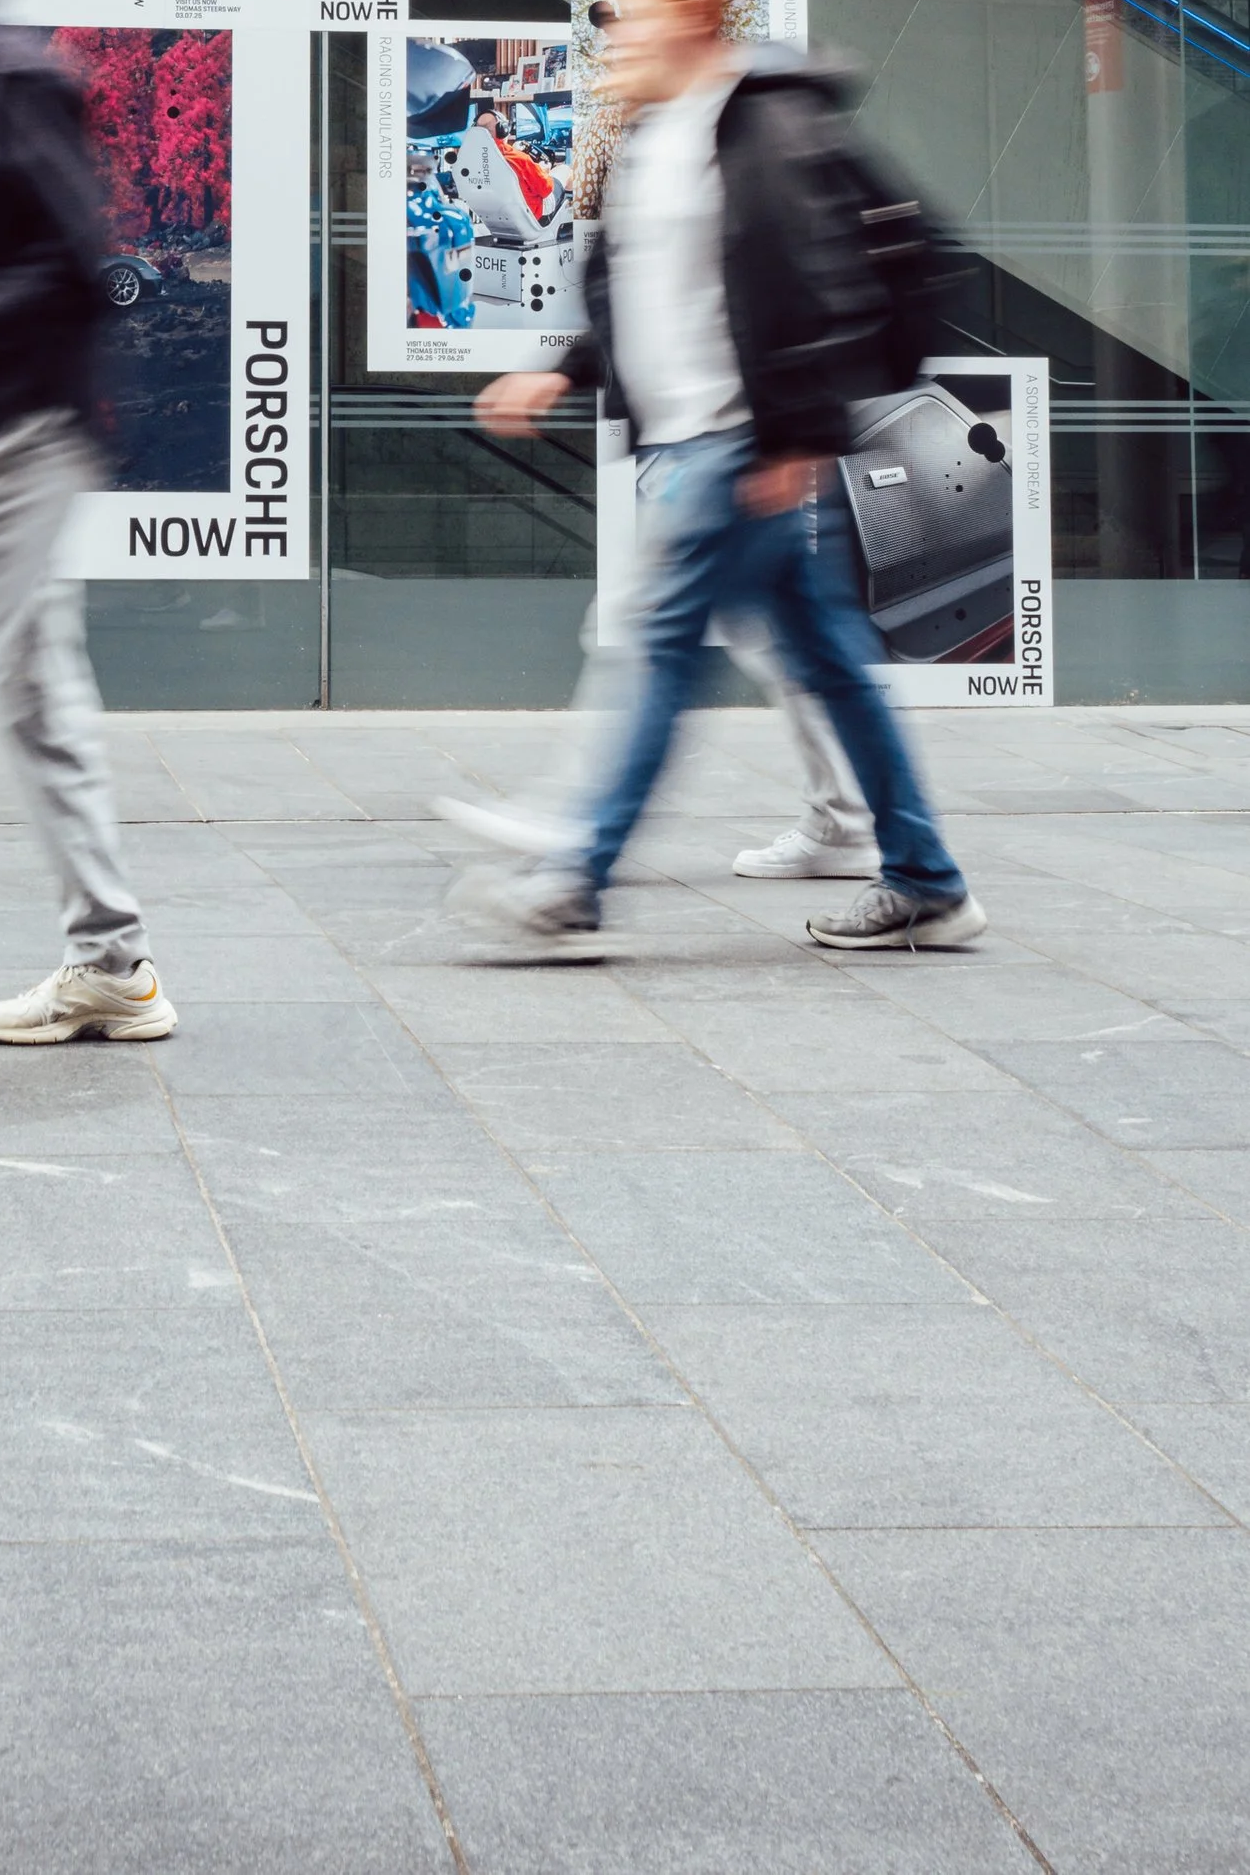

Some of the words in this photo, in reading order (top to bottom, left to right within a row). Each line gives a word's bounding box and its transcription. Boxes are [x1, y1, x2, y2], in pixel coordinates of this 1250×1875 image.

[321, 1, 372, 20] NOW
[379, 36, 392, 87] RACING
[379, 91, 392, 179] SIMULATORS
[482, 147, 490, 185] PORSCHE
[475, 256, 507, 273] SCHE
[1026, 374, 1038, 383] A
[1026, 387, 1038, 428] SONIC
[245, 321, 288, 557] PORSCHE
[1027, 433, 1038, 457] DAY
[1027, 462, 1040, 509] DREAM
[130, 517, 236, 557] NOW
[1021, 580, 1042, 695] PORSCHE
[969, 676, 1018, 695] NOW
